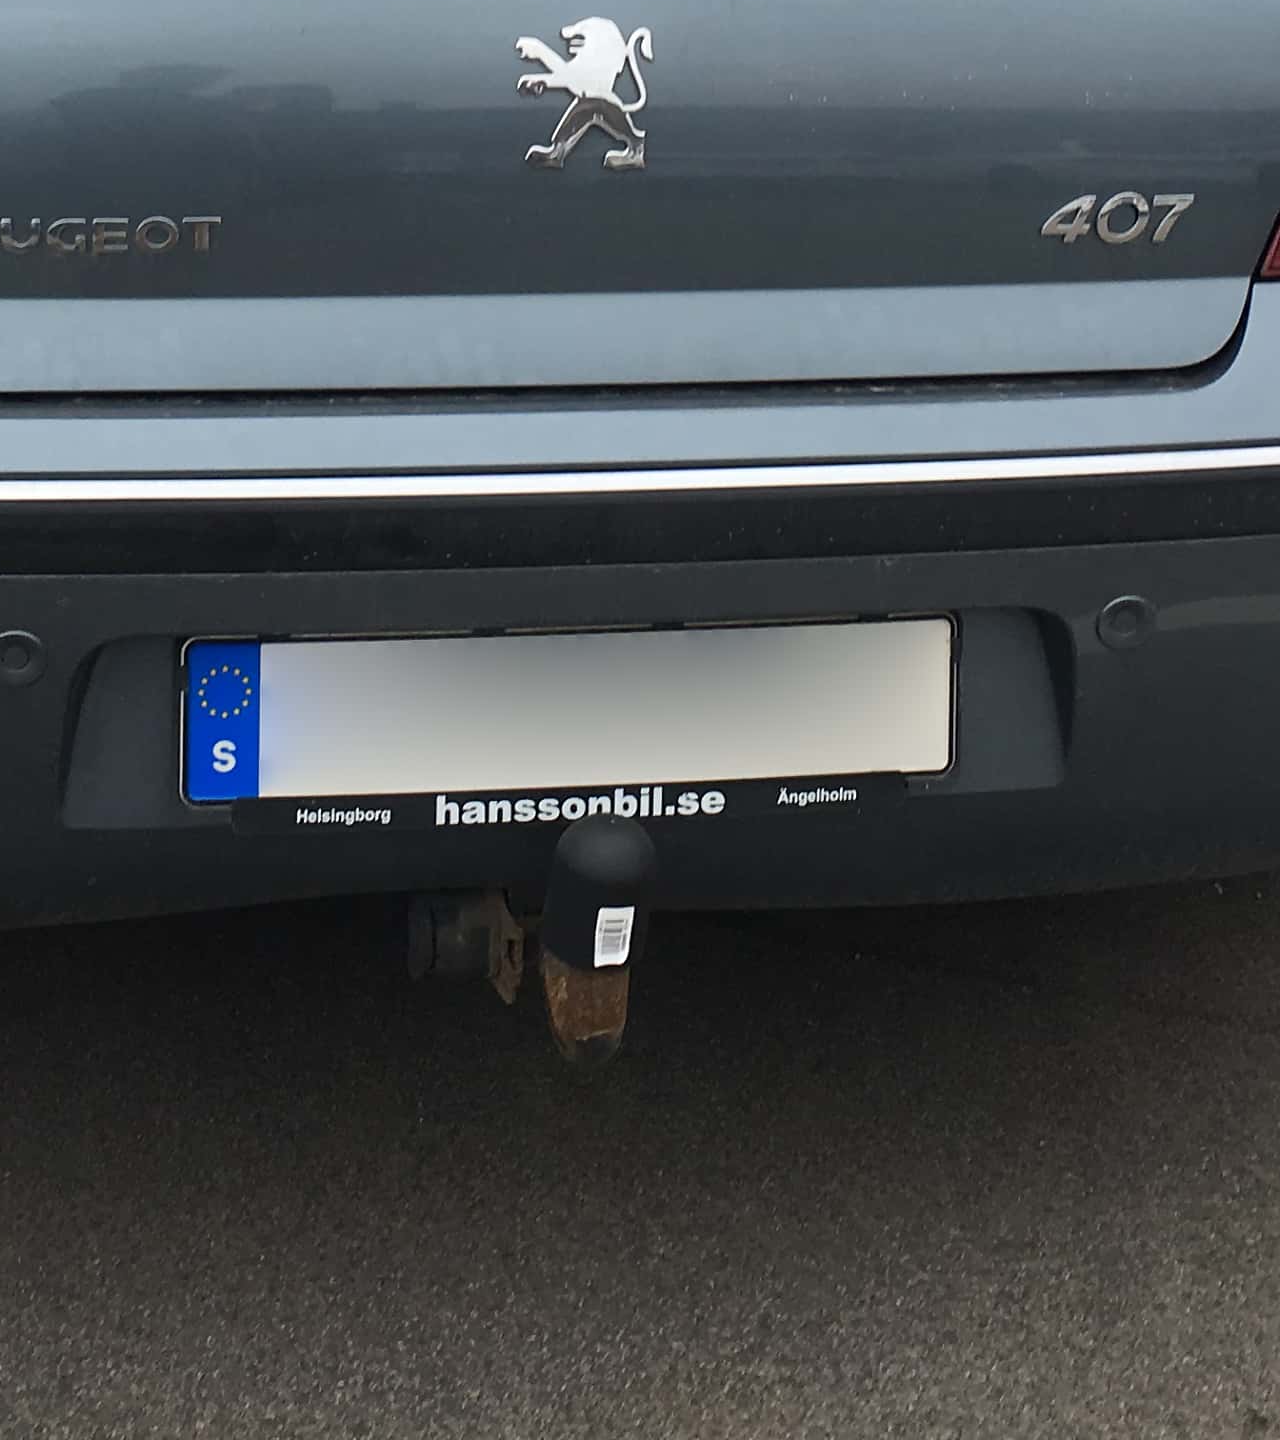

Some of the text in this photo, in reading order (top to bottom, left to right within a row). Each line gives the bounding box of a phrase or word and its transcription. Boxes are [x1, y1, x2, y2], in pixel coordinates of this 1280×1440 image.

[1040, 191, 1195, 244] 407
[213, 740, 236, 773] S
[435, 787, 725, 825] hanssonbil.se
[777, 786, 857, 805] Ängelholm
[295, 807, 391, 825] Helsingborg
